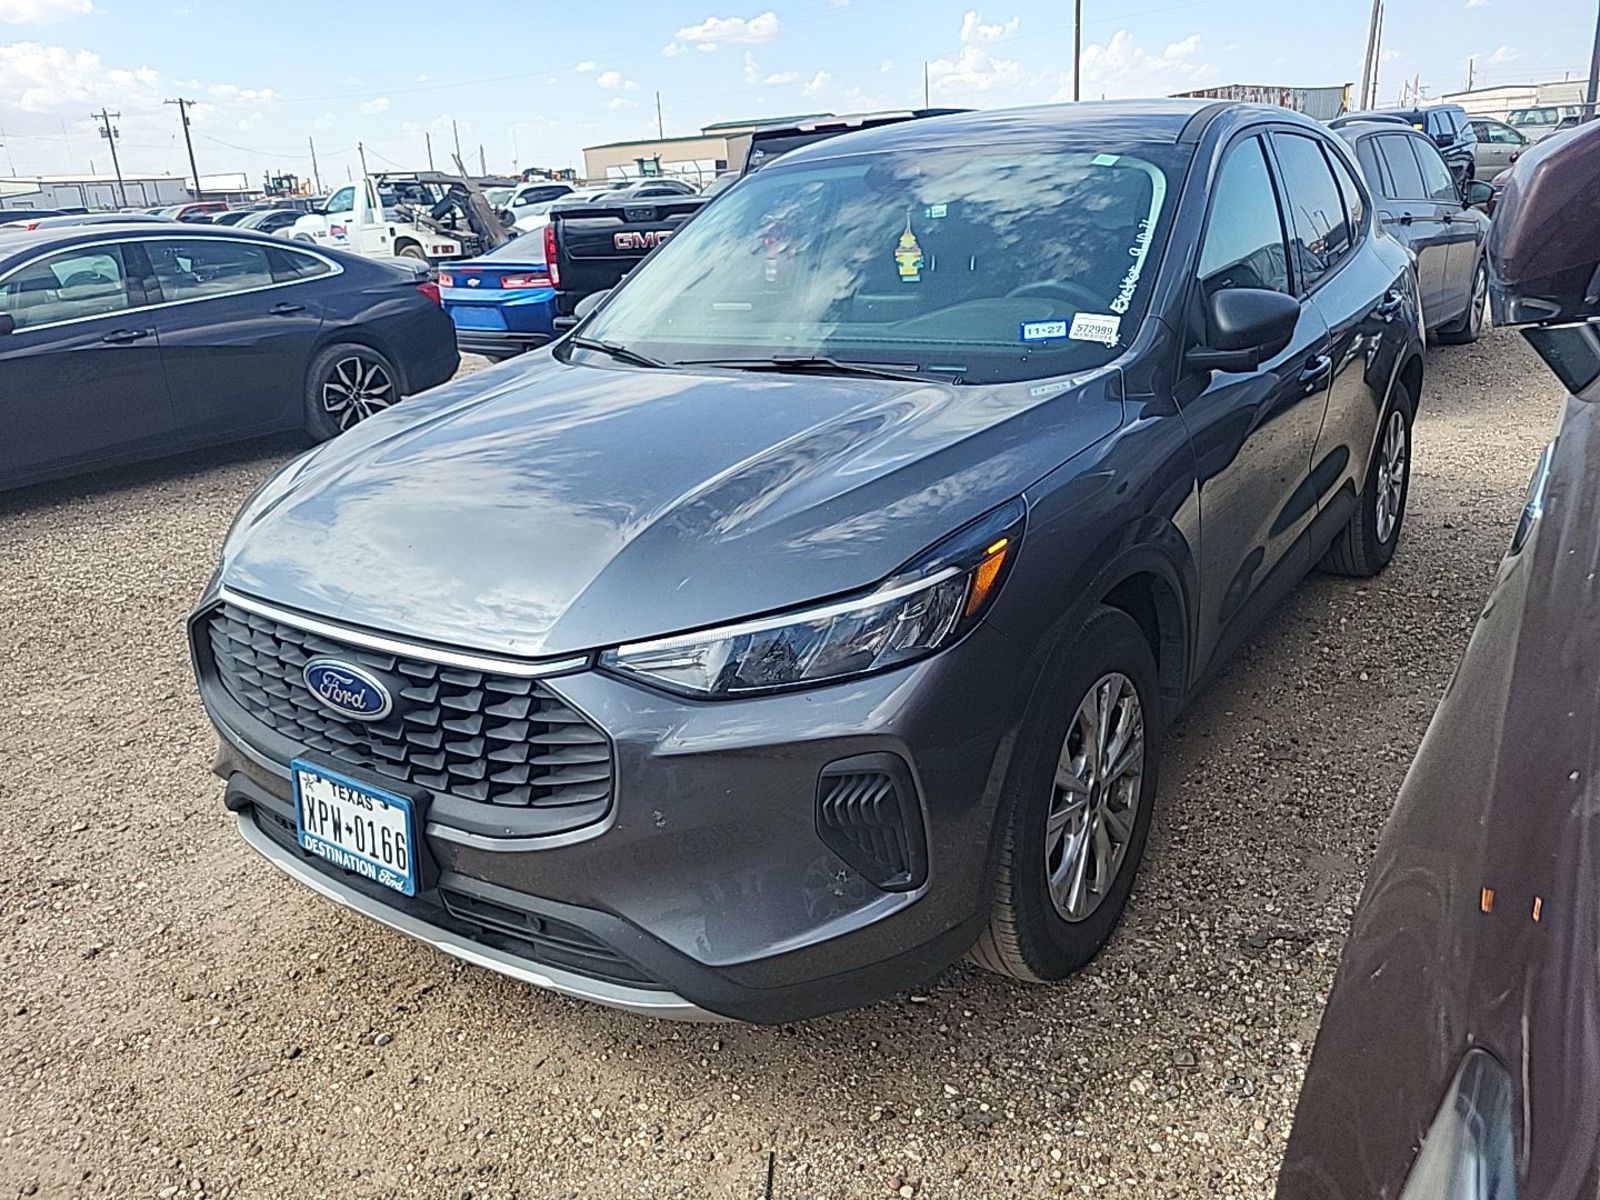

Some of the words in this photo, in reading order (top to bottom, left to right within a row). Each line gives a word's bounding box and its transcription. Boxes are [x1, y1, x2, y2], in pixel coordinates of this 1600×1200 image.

[319, 670, 368, 710] Ford
[330, 782, 374, 812] TEXAS
[304, 834, 376, 881] DESTINATION
[378, 867, 405, 892] Ford
